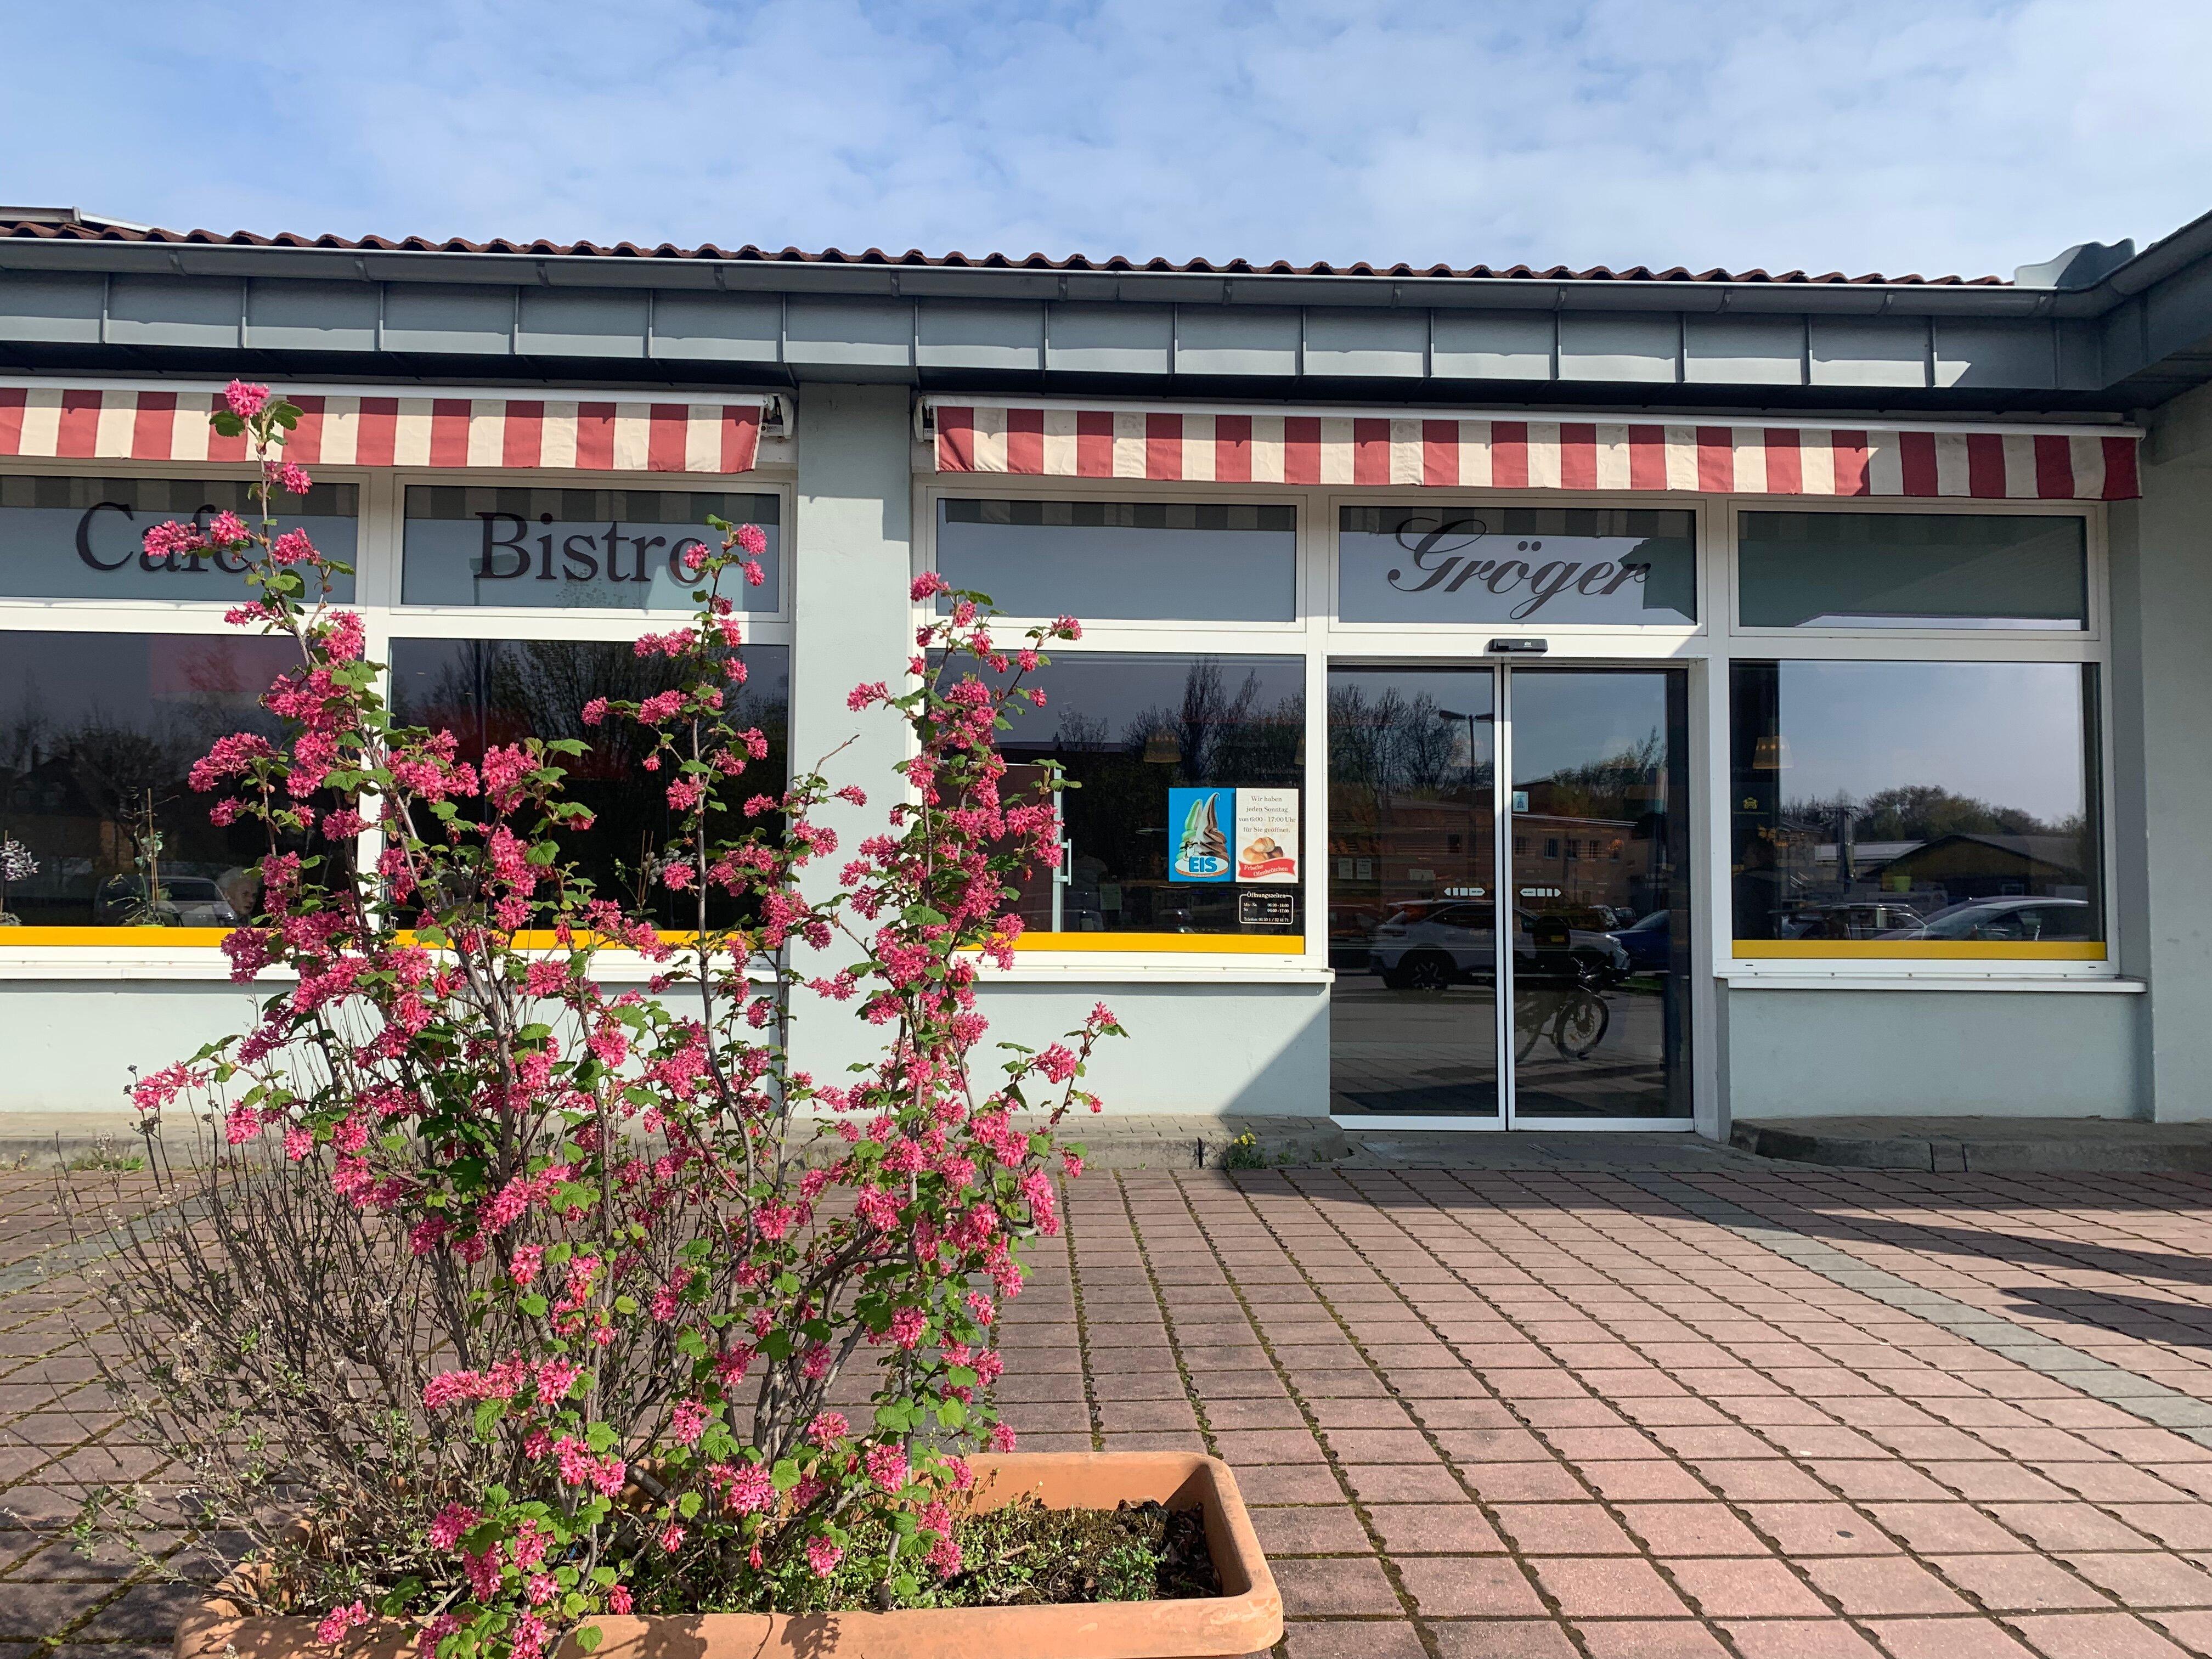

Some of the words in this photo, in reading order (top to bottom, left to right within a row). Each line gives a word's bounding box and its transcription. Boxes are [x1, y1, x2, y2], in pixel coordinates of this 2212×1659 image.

[473, 512, 710, 584] Bistro
[1387, 517, 1651, 620] Gröger
[1189, 857, 1217, 872] EIS
[1253, 866, 1288, 877] Ofenbrötchen
